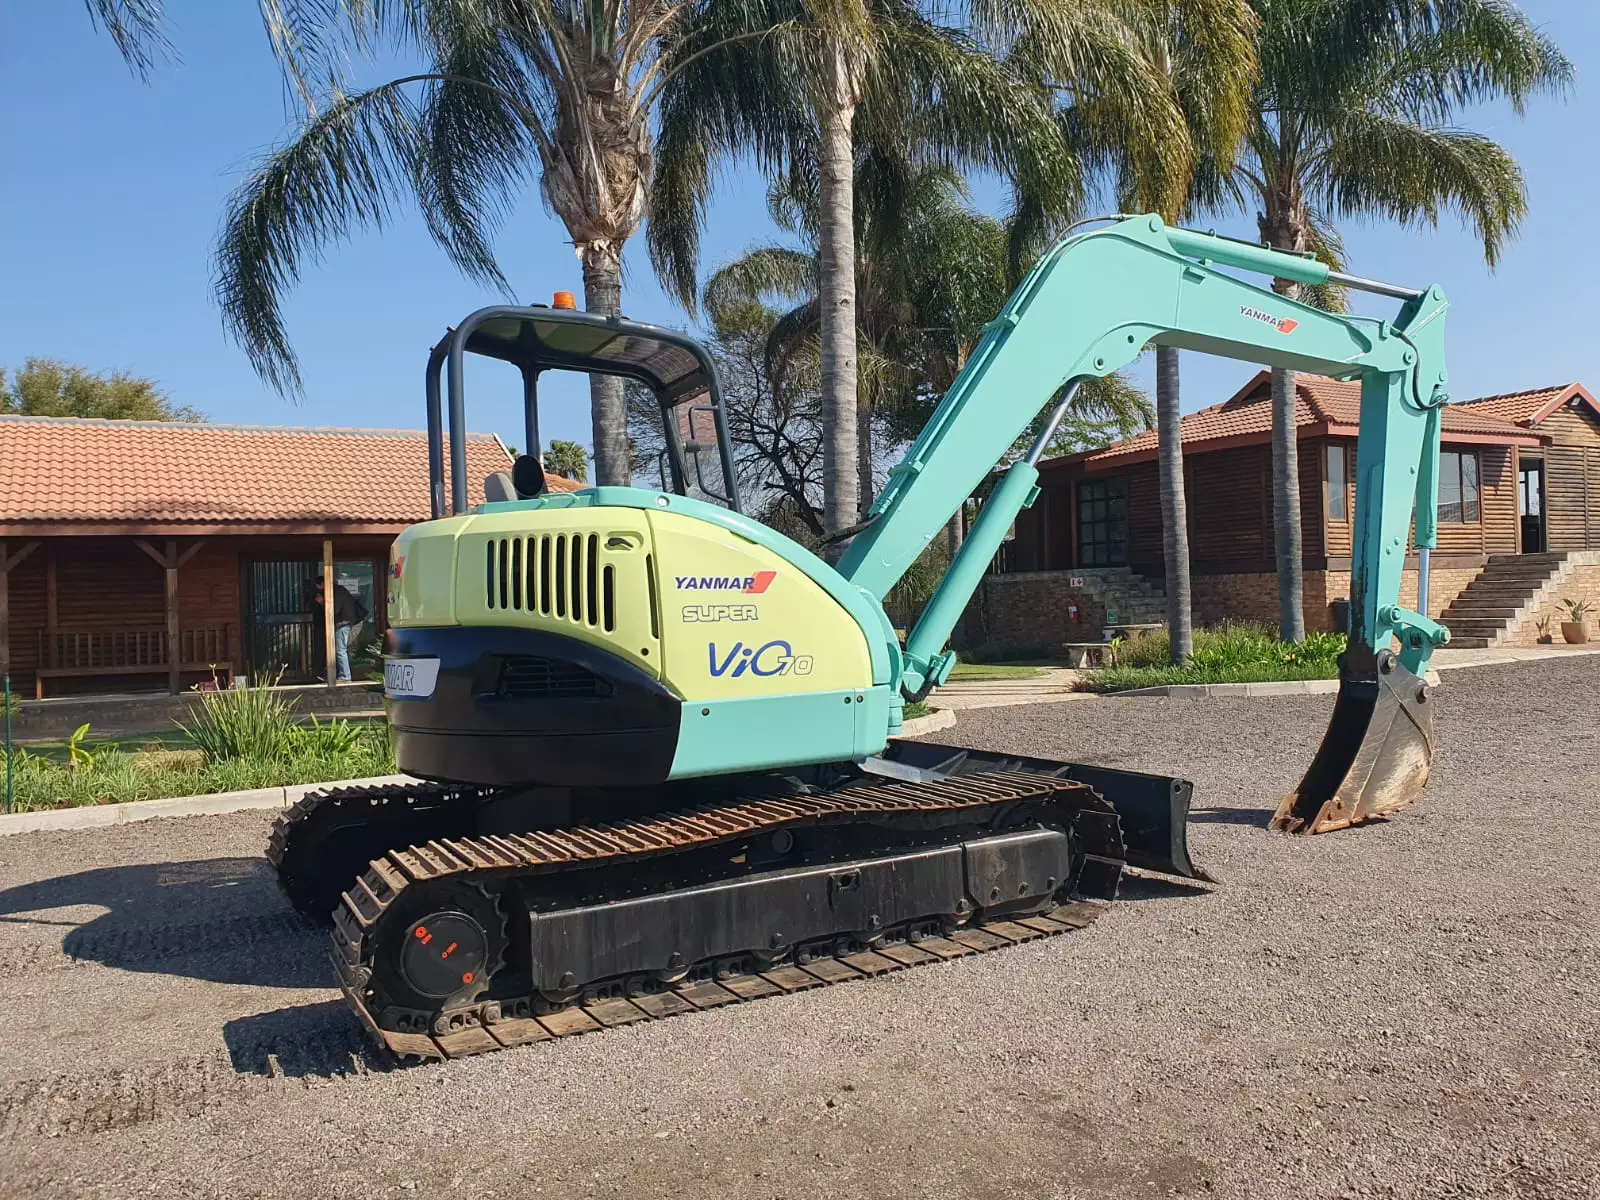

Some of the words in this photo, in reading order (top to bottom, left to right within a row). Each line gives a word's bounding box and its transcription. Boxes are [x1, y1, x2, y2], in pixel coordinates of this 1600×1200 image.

[1240, 305, 1285, 328] YANMAR
[675, 576, 755, 590] YANMAR
[682, 604, 759, 622] SUPER
